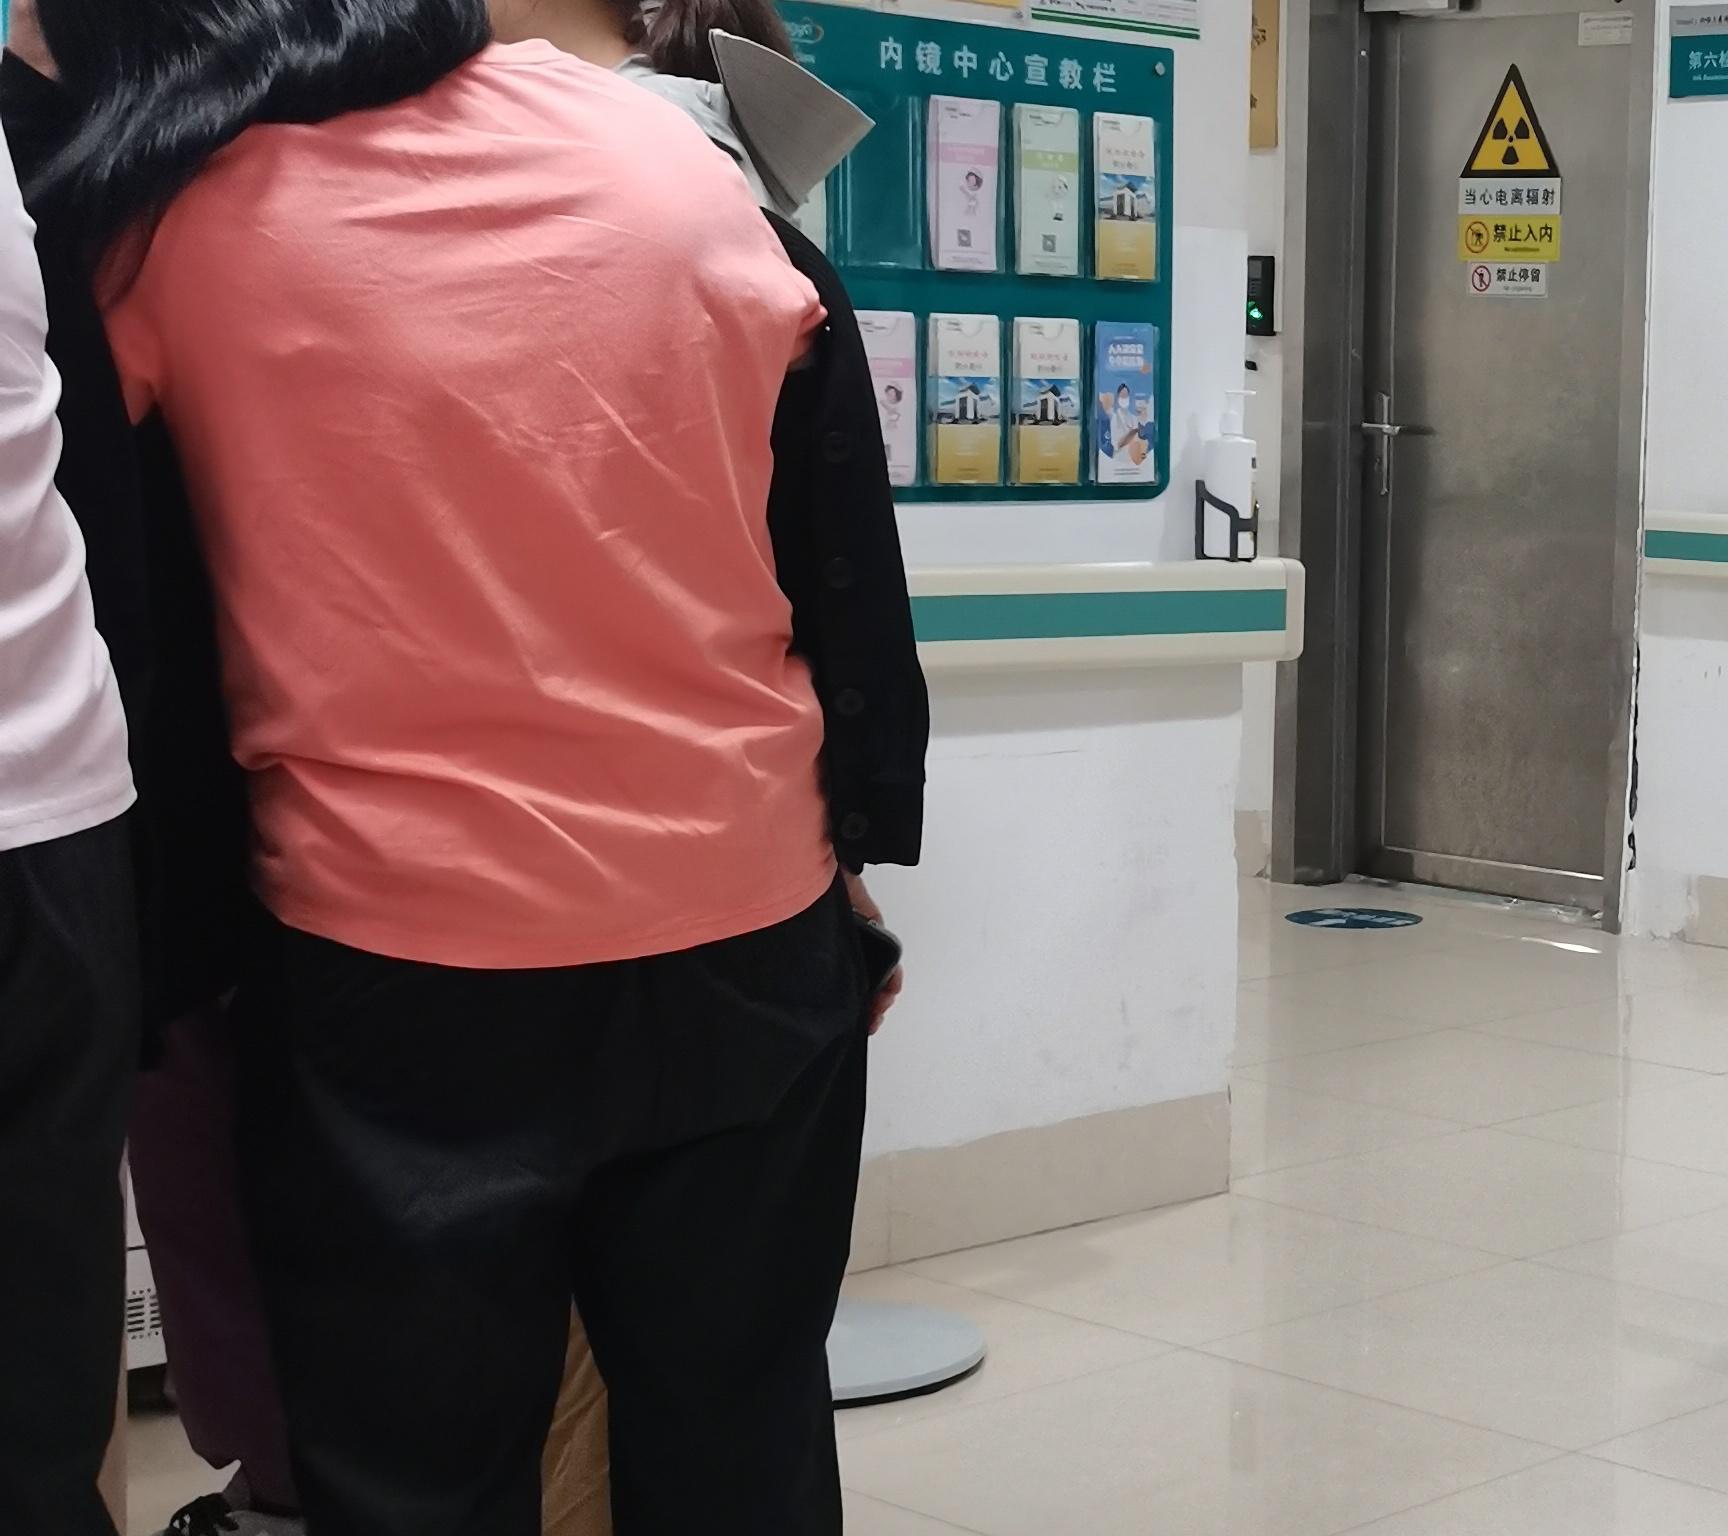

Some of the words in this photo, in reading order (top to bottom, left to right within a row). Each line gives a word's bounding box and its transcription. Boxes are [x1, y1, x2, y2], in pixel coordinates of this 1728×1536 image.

[879, 36, 1117, 93] 内镜中心宣教栏
[1465, 187, 1555, 206] 当心电离辐射
[1493, 223, 1553, 243] 禁止入内
[1496, 267, 1541, 282] 禁止停留
